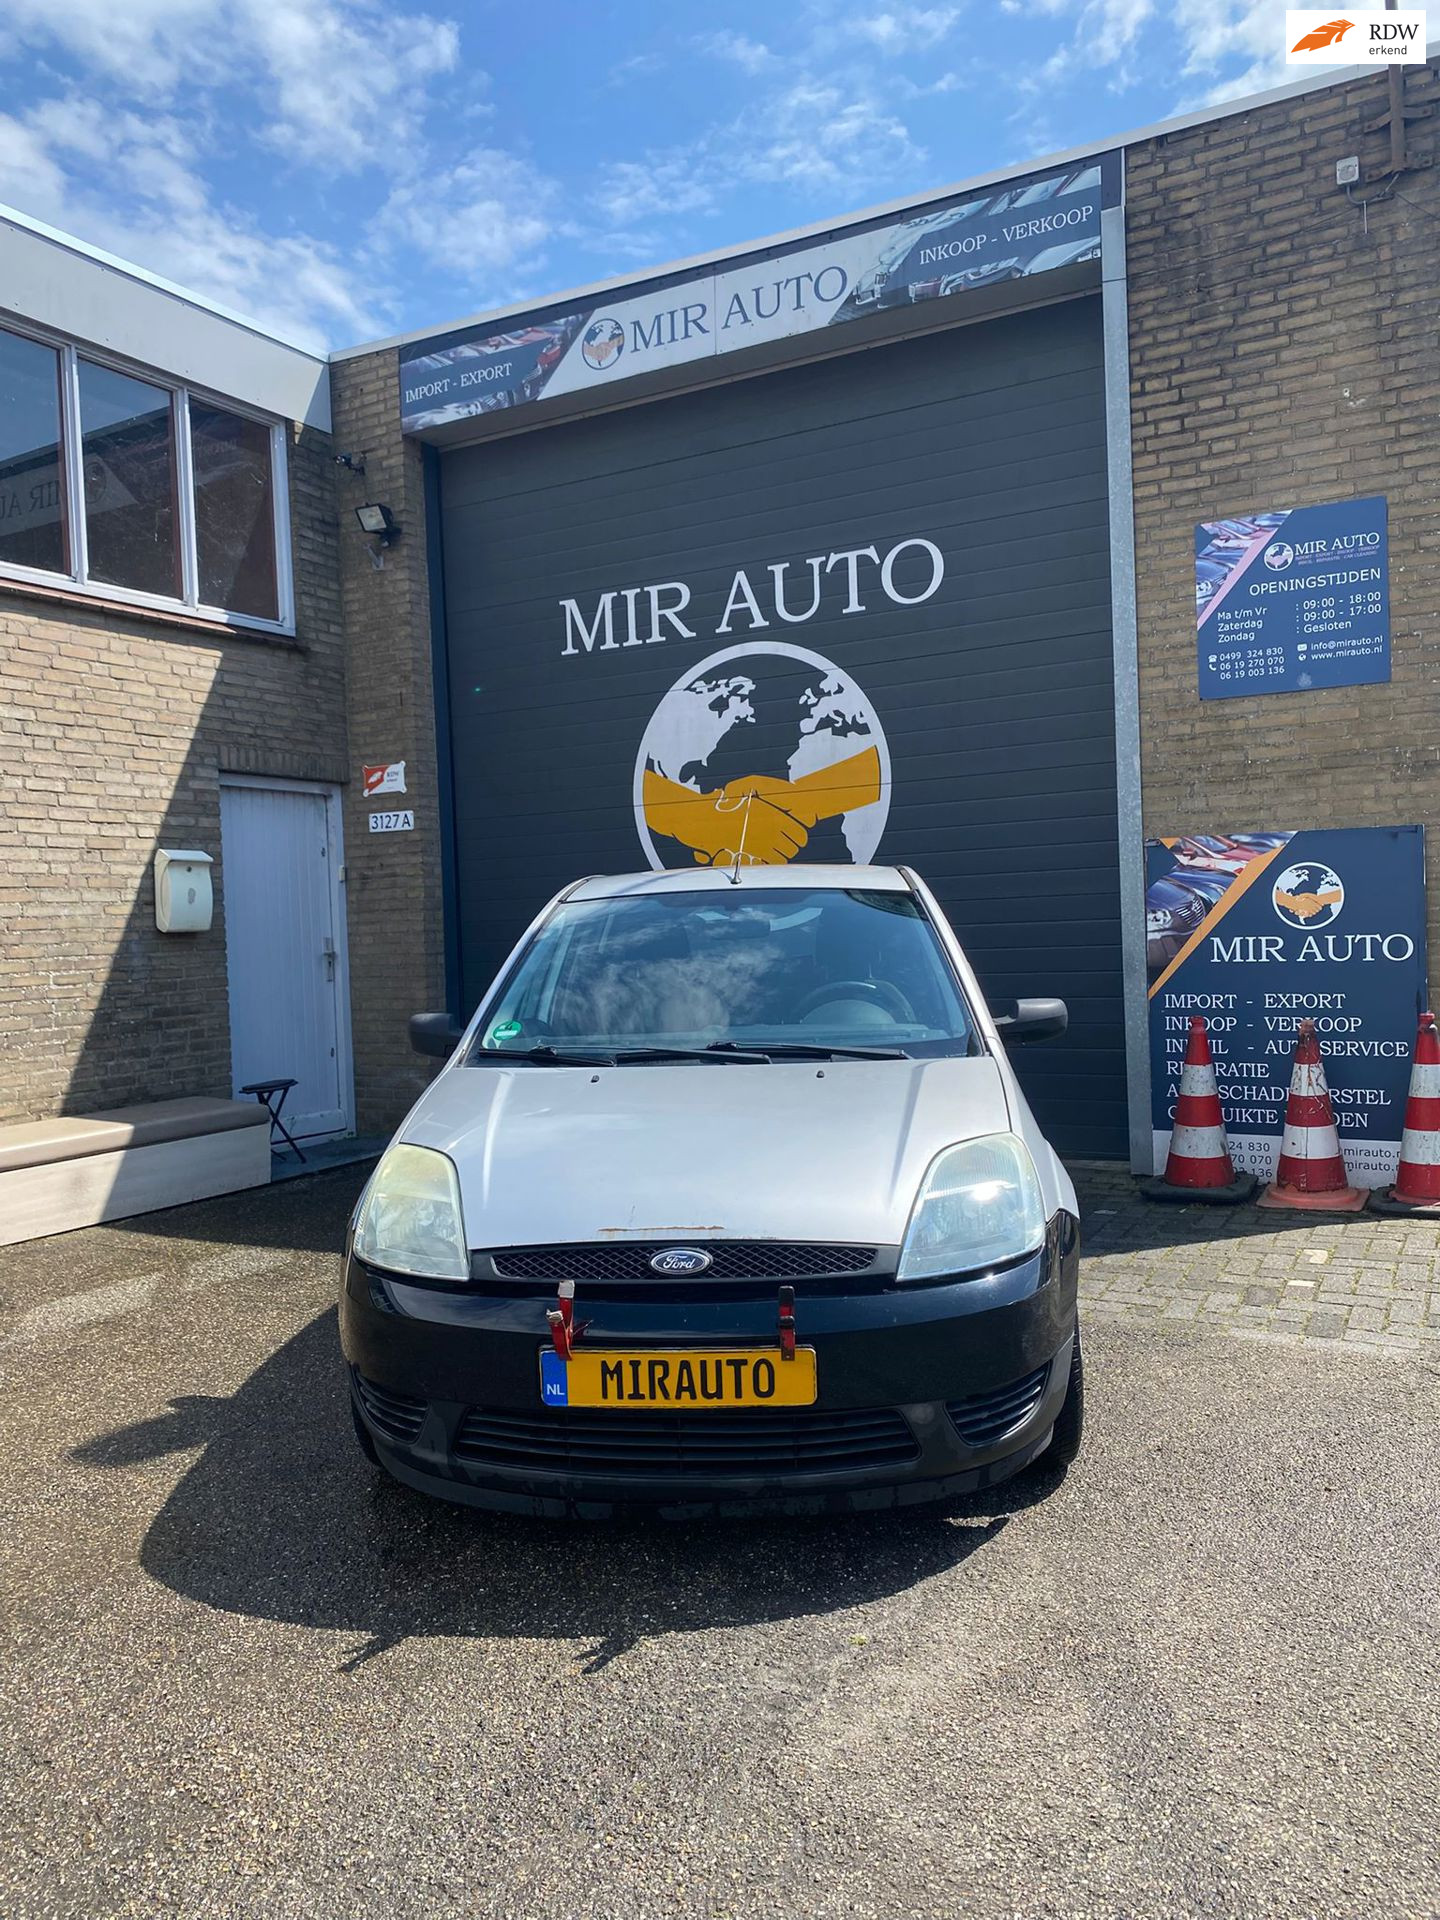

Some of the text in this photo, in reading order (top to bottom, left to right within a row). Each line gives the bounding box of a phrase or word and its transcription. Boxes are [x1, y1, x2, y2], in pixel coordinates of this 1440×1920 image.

[919, 234, 987, 265] INKOOP
[1002, 205, 1094, 242] VERKOOP
[629, 266, 848, 354] MIR AUTO
[405, 378, 450, 404] IMPORT
[460, 362, 513, 388] EXPORT
[1294, 540, 1327, 556] MIR
[1331, 532, 1380, 550] AUTO
[1249, 567, 1381, 596] OPENINGSTIJDEN
[558, 537, 945, 656] MIR AUTO
[1217, 611, 1232, 620] Ma
[1234, 609, 1253, 619] t/m
[1255, 607, 1267, 615] Vr
[1303, 597, 1335, 610] 09:00
[1349, 591, 1381, 604] 18:00
[1217, 619, 1263, 632] Zaterdag
[1303, 609, 1335, 621] 09:00
[1349, 603, 1381, 616] 17:00
[1218, 632, 1255, 643] Zondag
[1303, 621, 1352, 633] Gesloten
[1311, 635, 1383, 650] info@mirauto.nl
[1219, 647, 1283, 661] 0499 324 830
[1311, 645, 1383, 660] www.mirauto.nl
[1220, 656, 1284, 670] 06 19 270 070
[1220, 666, 1285, 680] 06 19 003 136
[371, 813, 411, 830] 3127 A
[1210, 933, 1414, 963] MIR AUTO
[1164, 994, 1237, 1009] IMPORT
[1264, 993, 1346, 1009] EXPORT
[1165, 1038, 1229, 1054] INIL
[1319, 1041, 1409, 1057] SERVICE
[1229, 1141, 1270, 1152] 24 830
[1231, 1153, 1272, 1165] 70 070
[662, 1255, 696, 1269] Ford
[601, 1358, 775, 1400] MIRAUTO
[546, 1383, 565, 1396] NL
